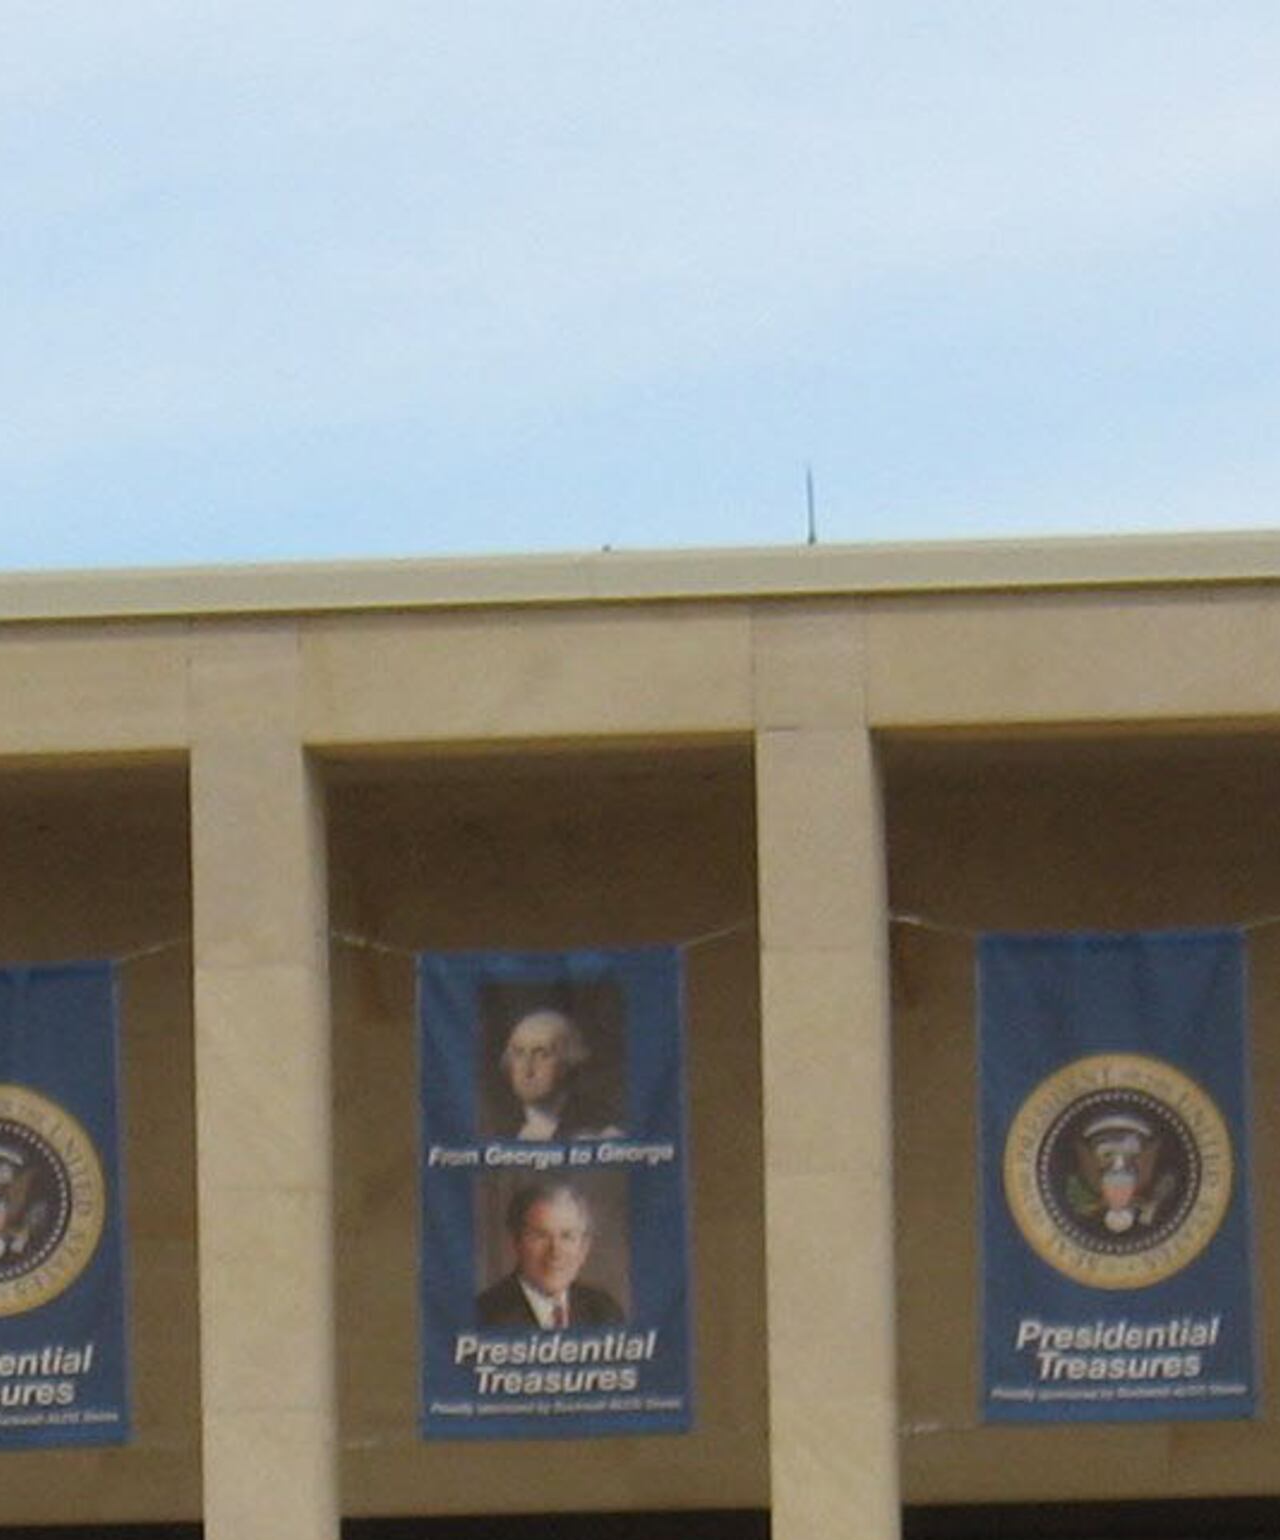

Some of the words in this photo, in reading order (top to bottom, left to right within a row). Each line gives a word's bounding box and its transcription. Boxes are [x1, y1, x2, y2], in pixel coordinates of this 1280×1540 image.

[428, 1148, 479, 1167] From
[485, 1145, 564, 1168] George
[569, 1147, 590, 1164] to
[596, 1143, 674, 1165] George
[455, 1331, 657, 1366] Presidential
[1016, 1318, 1220, 1351] Presidential
[1036, 1350, 1202, 1380] Treasures
[474, 1366, 638, 1395] Treasures
